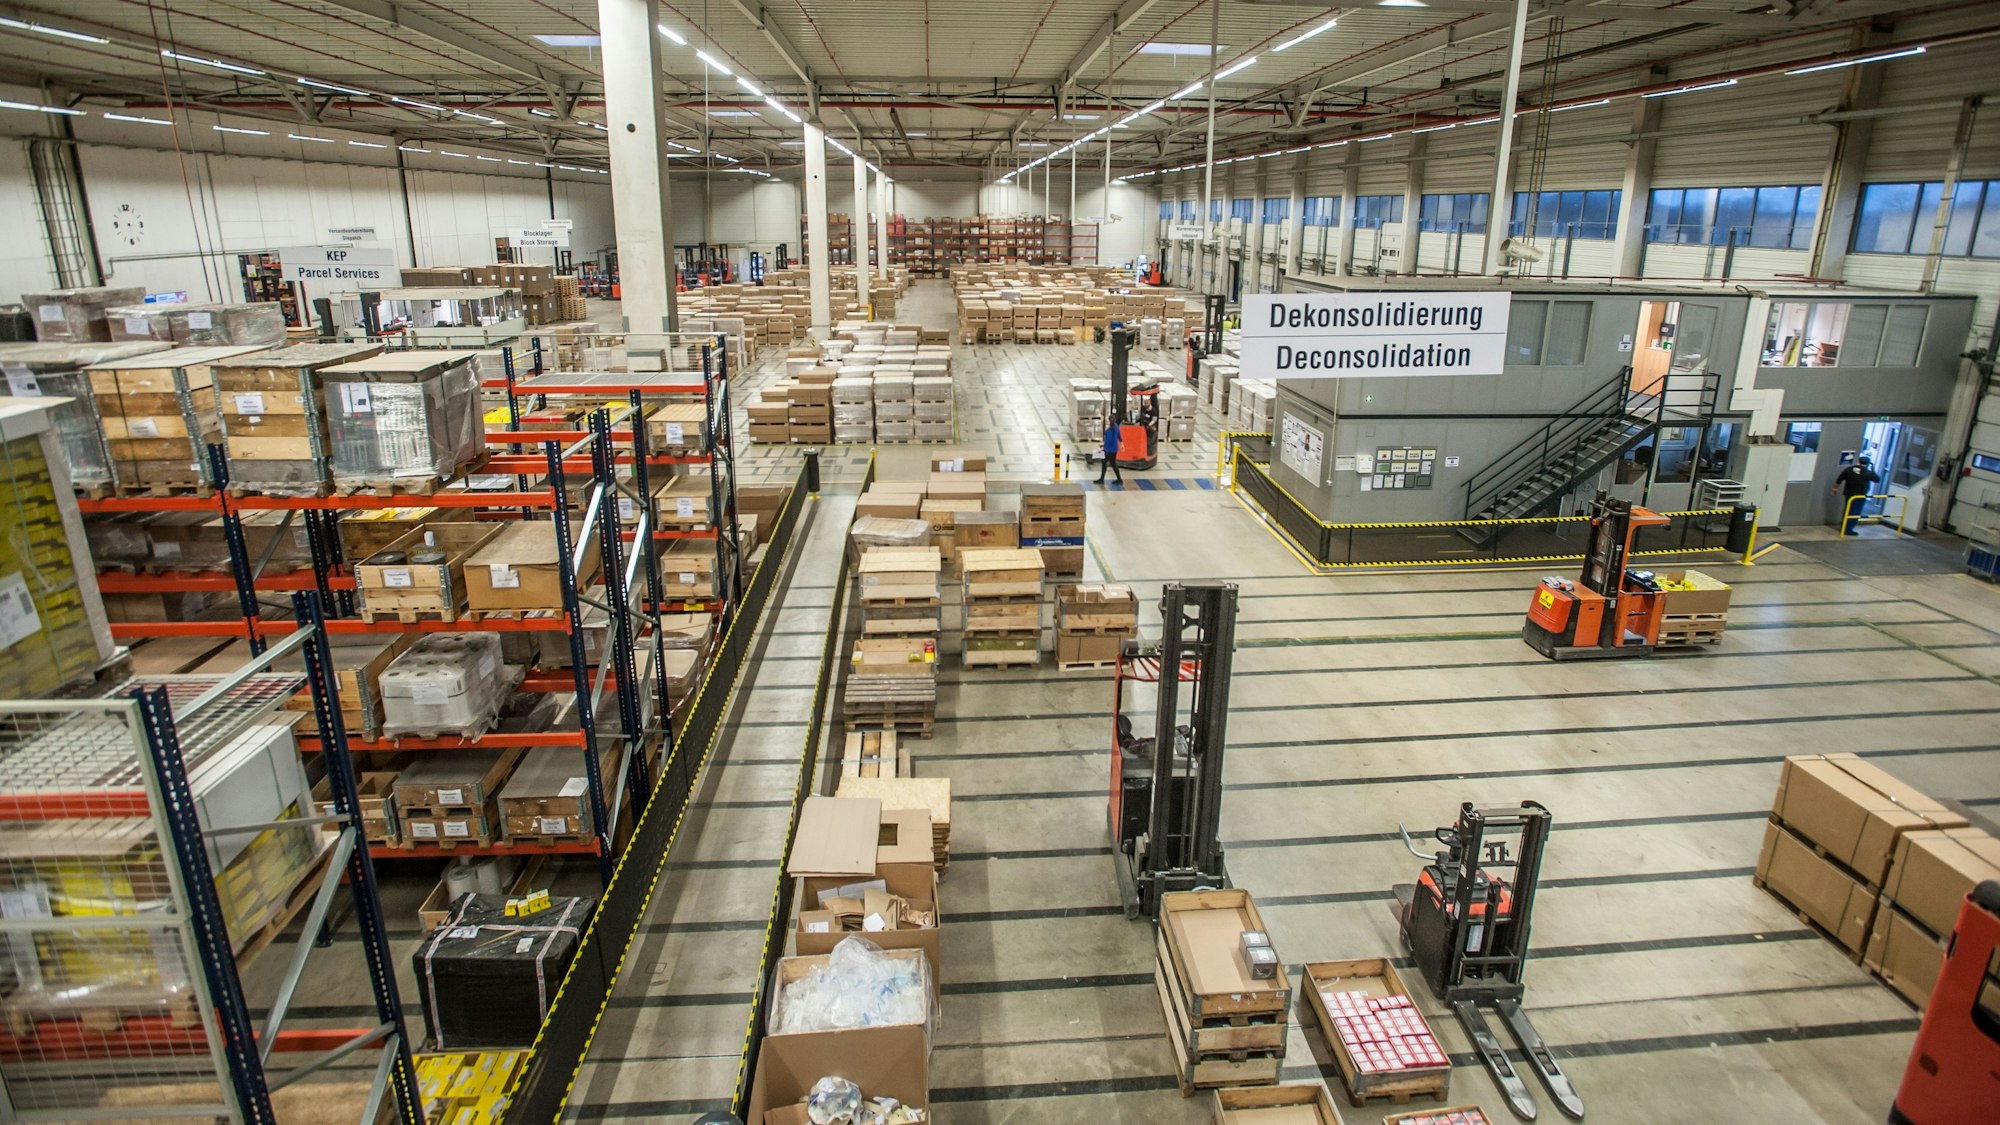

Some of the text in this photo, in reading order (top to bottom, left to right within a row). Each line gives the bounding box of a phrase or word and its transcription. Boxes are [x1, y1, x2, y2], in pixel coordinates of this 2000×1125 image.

[326, 250, 347, 262] KEP
[298, 267, 380, 279] Parcel Services
[1270, 302, 1483, 330] Dekonsolidierung
[1276, 342, 1471, 370] Deconsolidation
